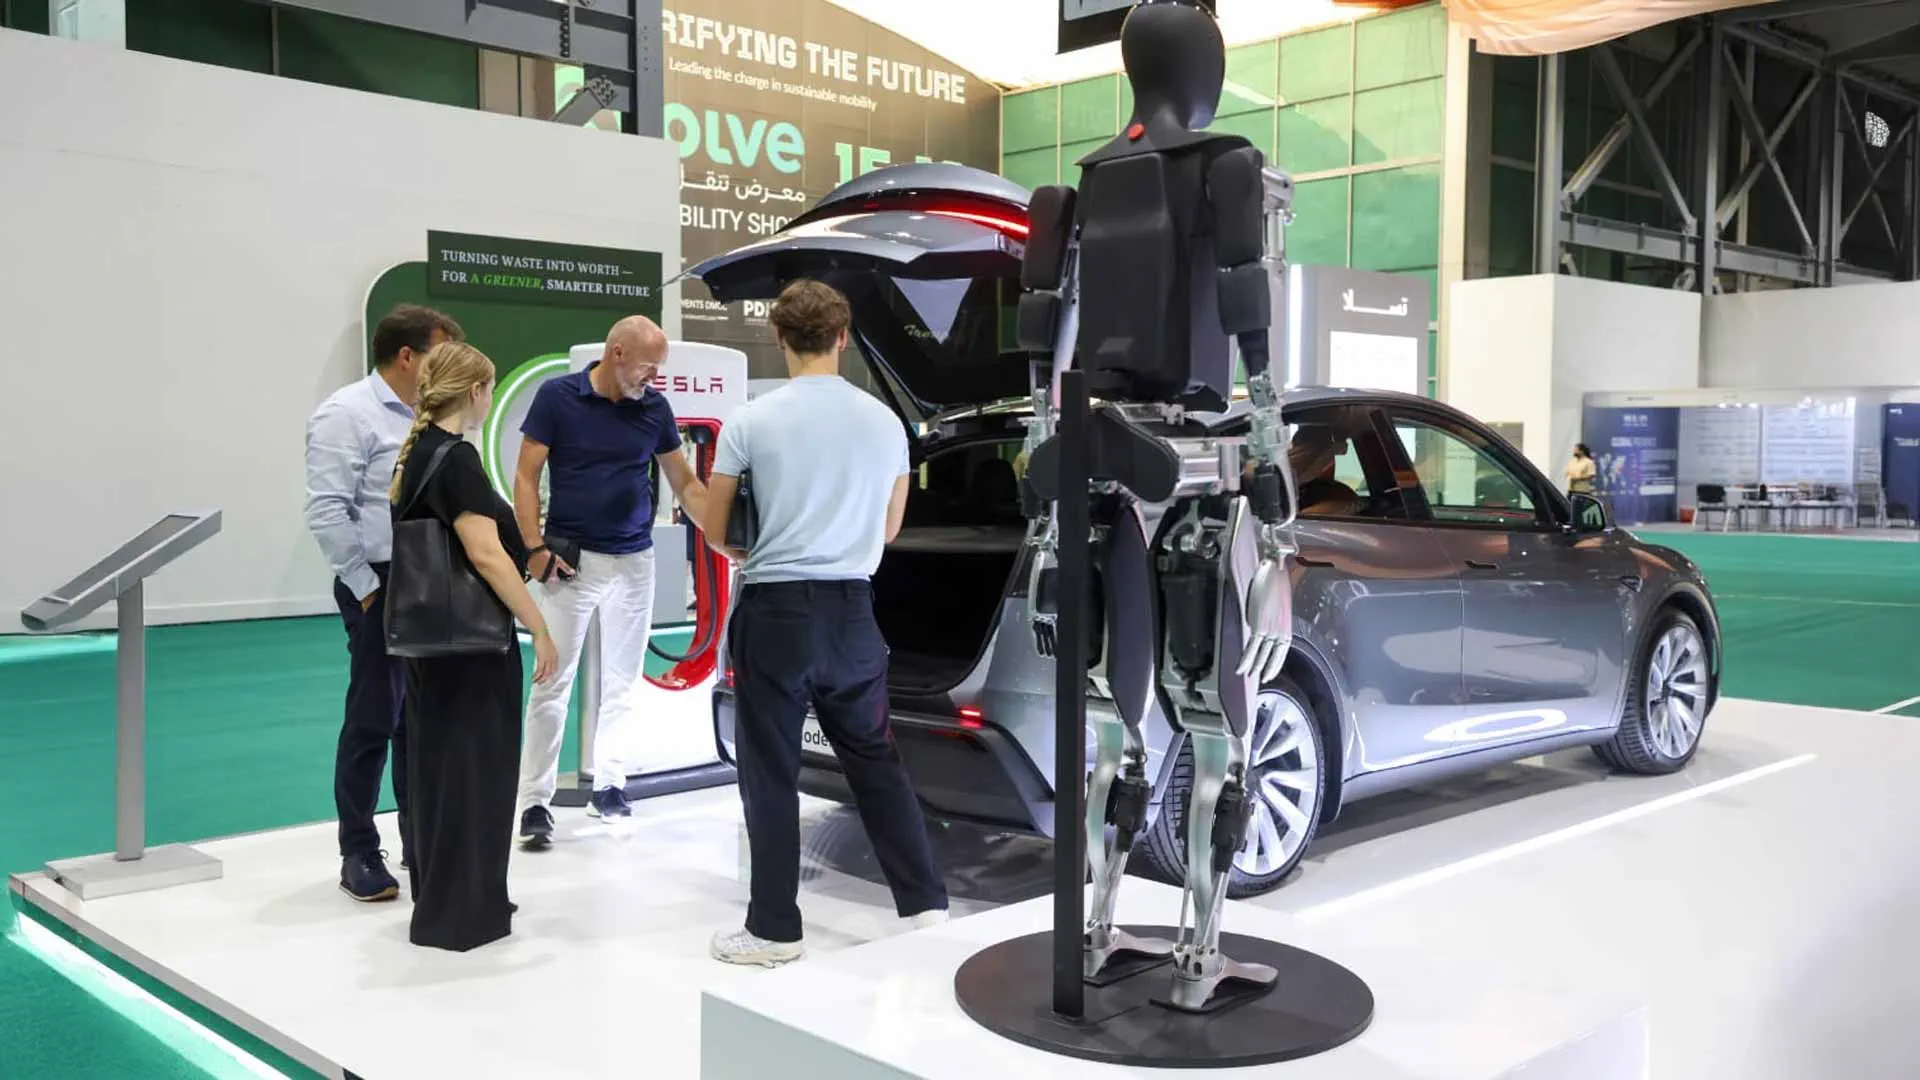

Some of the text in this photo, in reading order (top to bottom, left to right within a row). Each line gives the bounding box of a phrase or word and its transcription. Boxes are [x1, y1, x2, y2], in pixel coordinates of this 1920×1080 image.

[669, 57, 878, 112] Leading the charge in sustainable mobility
[804, 40, 858, 82] THE
[867, 55, 966, 104] FUTURE
[735, 178, 806, 204] معرض
[747, 212, 795, 235] SHO
[441, 249, 499, 266] TURNING
[501, 255, 544, 270] WASTE
[546, 259, 575, 272] INTO
[577, 262, 620, 276] WORTH
[441, 270, 650, 297] FOR A GREENER, SMARTER FUTURE
[802, 730, 831, 746] ode
